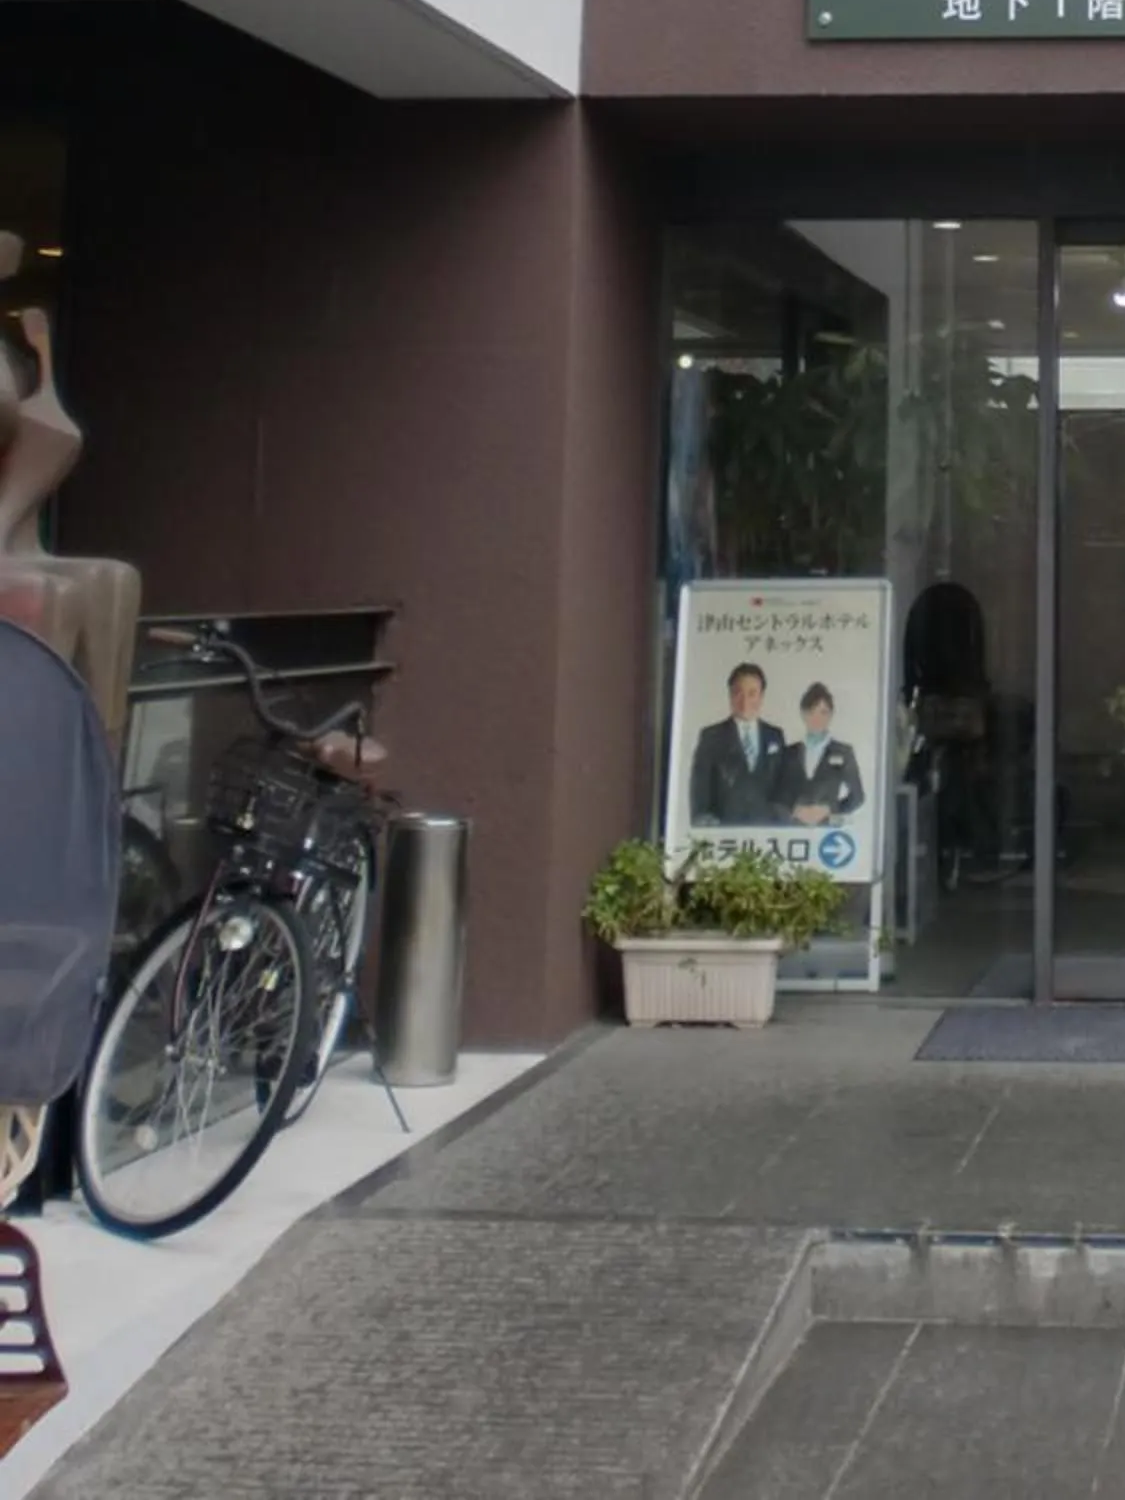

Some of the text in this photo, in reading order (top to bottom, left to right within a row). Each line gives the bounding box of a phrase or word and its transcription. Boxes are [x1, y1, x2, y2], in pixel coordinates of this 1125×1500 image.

[697, 612, 870, 633] 津山セントラルホテル
[744, 634, 825, 653] アネックス
